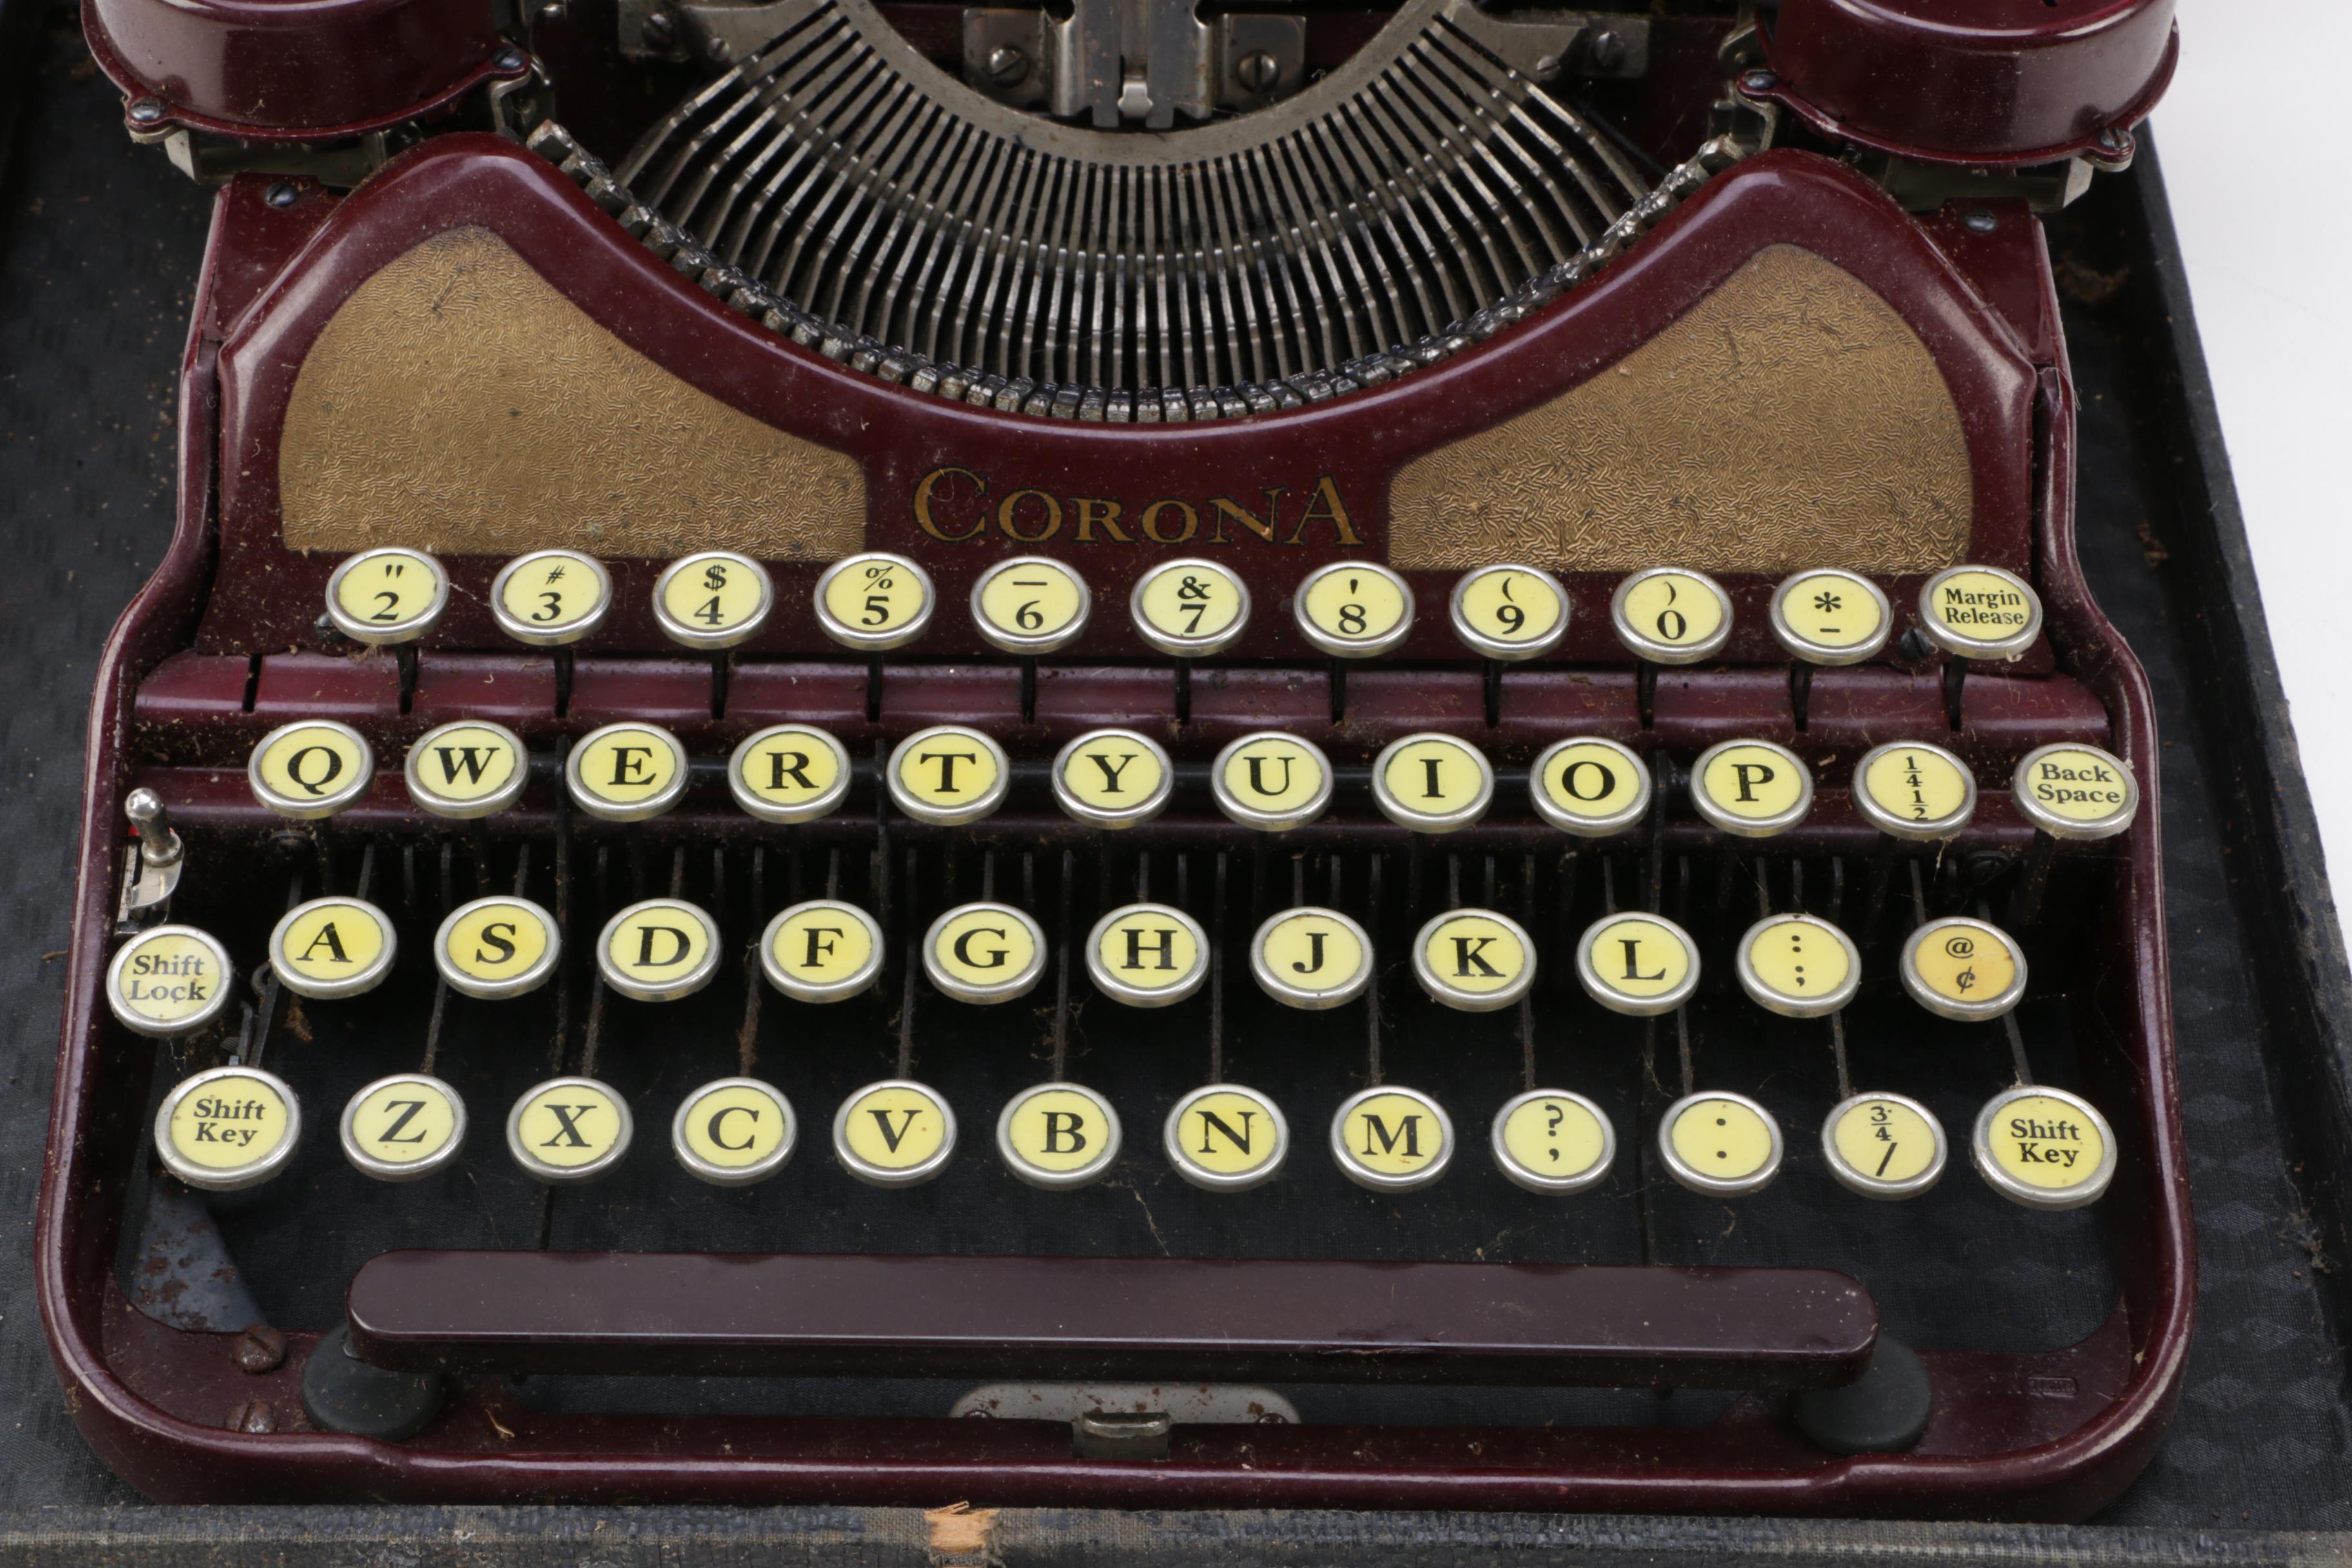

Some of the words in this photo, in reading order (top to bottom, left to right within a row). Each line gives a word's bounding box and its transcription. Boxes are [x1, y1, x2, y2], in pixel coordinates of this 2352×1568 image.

[912, 466, 1366, 545] CORONA
[546, 566, 565, 585] #
[703, 564, 727, 592] $
[863, 565, 894, 592] %
[1177, 576, 1211, 600] &
[1502, 577, 1514, 602] (
[370, 591, 400, 621] 2
[531, 592, 562, 622] 3
[694, 595, 724, 625] 4
[861, 595, 890, 625] 5
[1665, 582, 1676, 606] )
[1945, 587, 2021, 610] Margin
[1015, 600, 1044, 630] 6
[1179, 603, 1207, 633] 7
[1338, 603, 1367, 635] 8
[1496, 605, 1525, 635] 9
[1656, 610, 1687, 640] 0
[1944, 606, 2024, 625] Release
[287, 746, 343, 795] Q
[433, 747, 500, 785] W
[607, 747, 656, 785] E
[765, 752, 819, 790] R
[919, 752, 976, 793] T
[1086, 754, 1139, 793] Y
[1242, 756, 1296, 796] U
[1419, 758, 1446, 798] I
[1561, 761, 1616, 801] O
[1730, 763, 1775, 802] P
[2040, 763, 2112, 783] Back
[2037, 783, 2121, 805] Space
[296, 921, 353, 963] A
[475, 923, 516, 965] S
[632, 926, 691, 966] D
[800, 928, 844, 968] F
[954, 928, 1010, 968] G
[1121, 928, 1178, 970] H
[1292, 932, 1329, 974] J
[1449, 937, 1507, 977] K
[1945, 937, 1974, 959] @
[133, 953, 204, 976] Shift
[1618, 939, 1666, 981] L
[130, 979, 207, 1001] Lock
[193, 1099, 266, 1121] Shift
[378, 1101, 427, 1143] Z
[540, 1104, 597, 1148] X
[1545, 1104, 1563, 1137] ?
[195, 1122, 257, 1147] Key
[707, 1107, 760, 1150] C
[867, 1110, 923, 1153] V
[1041, 1112, 1086, 1153] B
[1195, 1111, 1256, 1155] N
[1361, 1114, 1424, 1157] M
[2010, 1119, 2081, 1141] Shift
[2018, 1142, 2079, 1168] Key
